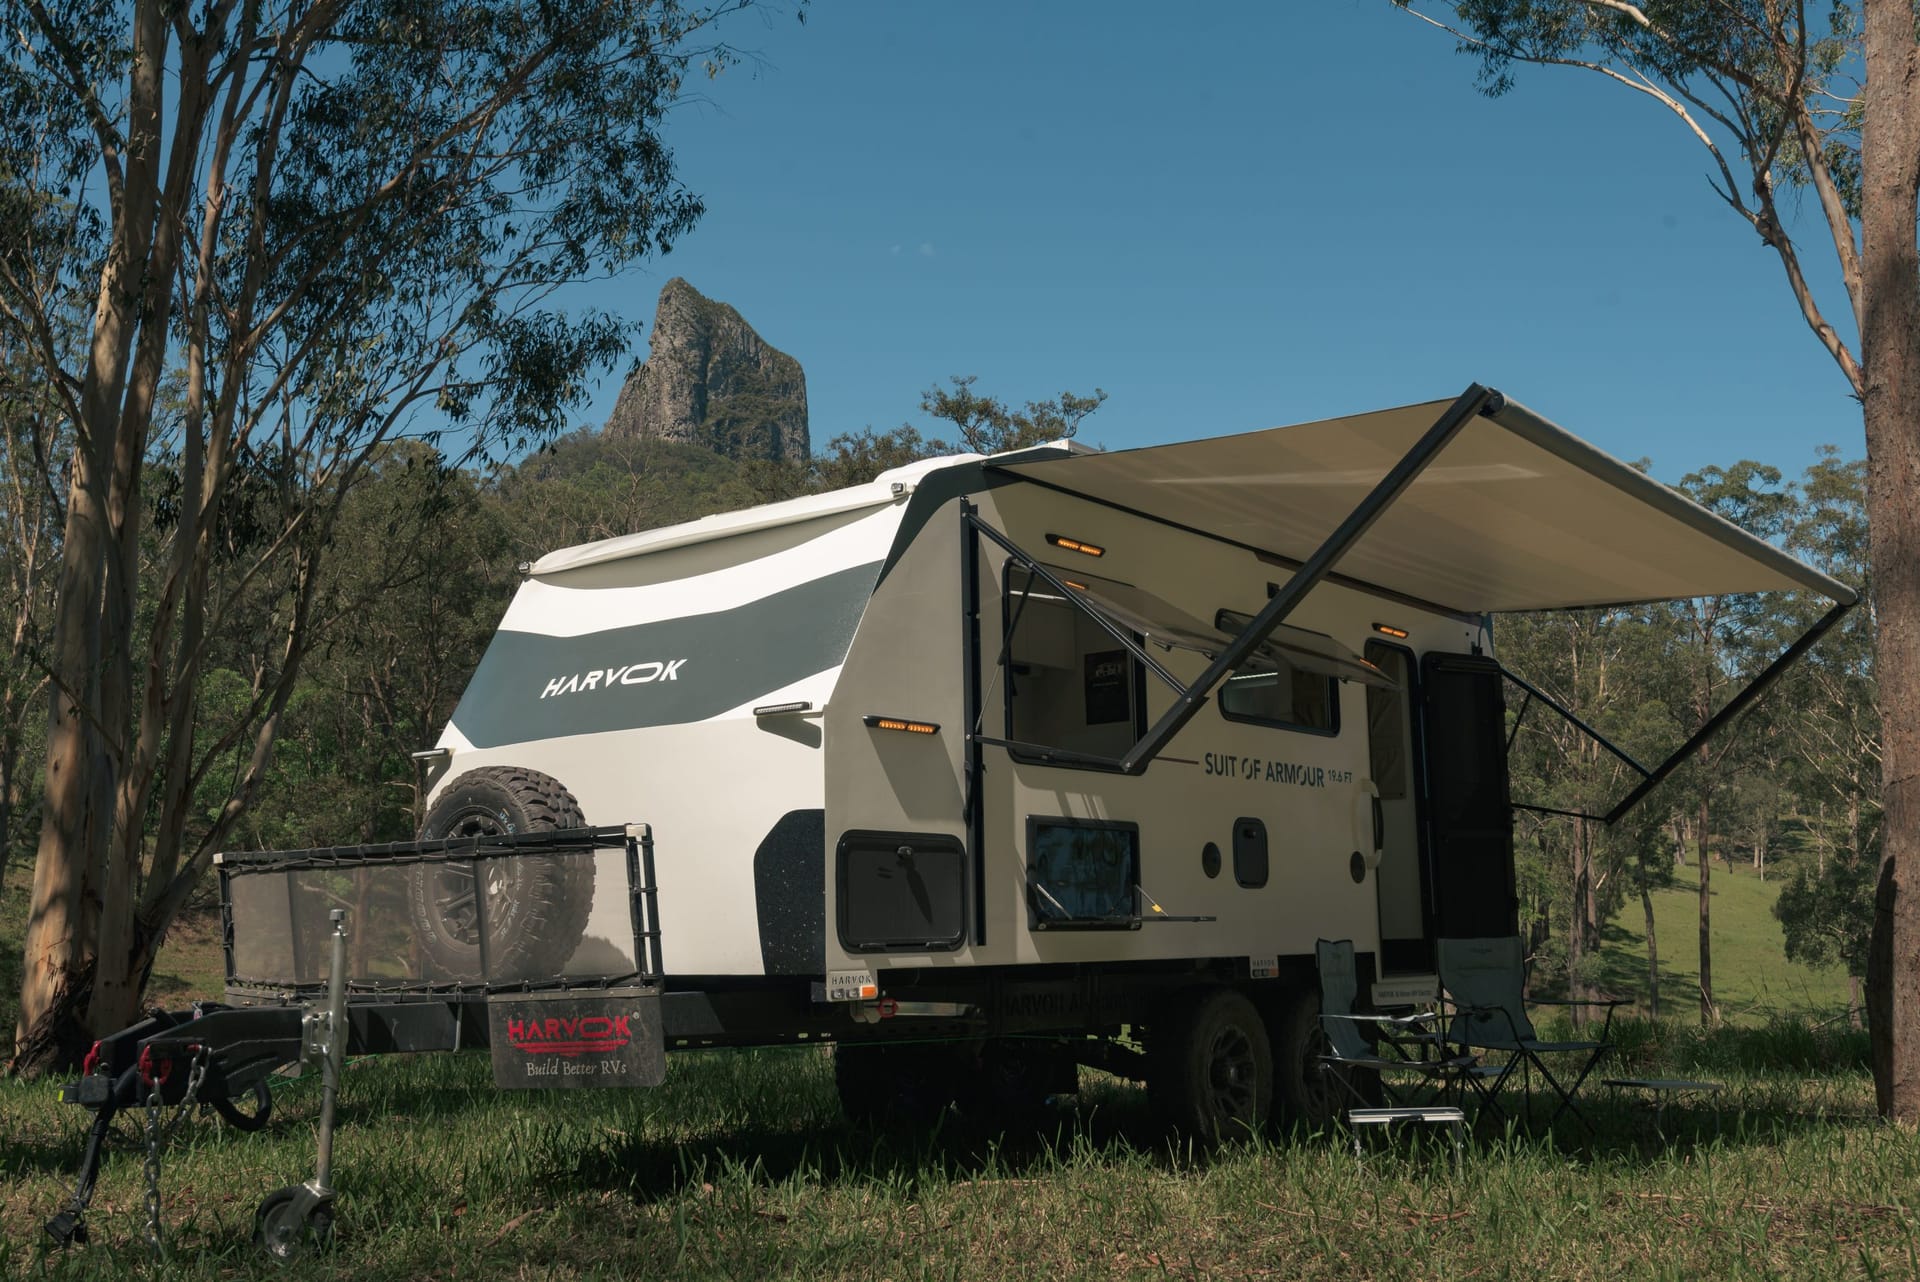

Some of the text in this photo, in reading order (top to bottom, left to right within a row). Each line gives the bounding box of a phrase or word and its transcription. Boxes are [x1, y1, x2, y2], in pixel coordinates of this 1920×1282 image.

[539, 658, 688, 700] HARVOK
[1204, 752, 1353, 788] SUIT OF ARMOUR 19.6 FT
[831, 974, 872, 985] HARVOK
[507, 1015, 632, 1041] HARVOK
[526, 1058, 627, 1076] Build Better RVs
